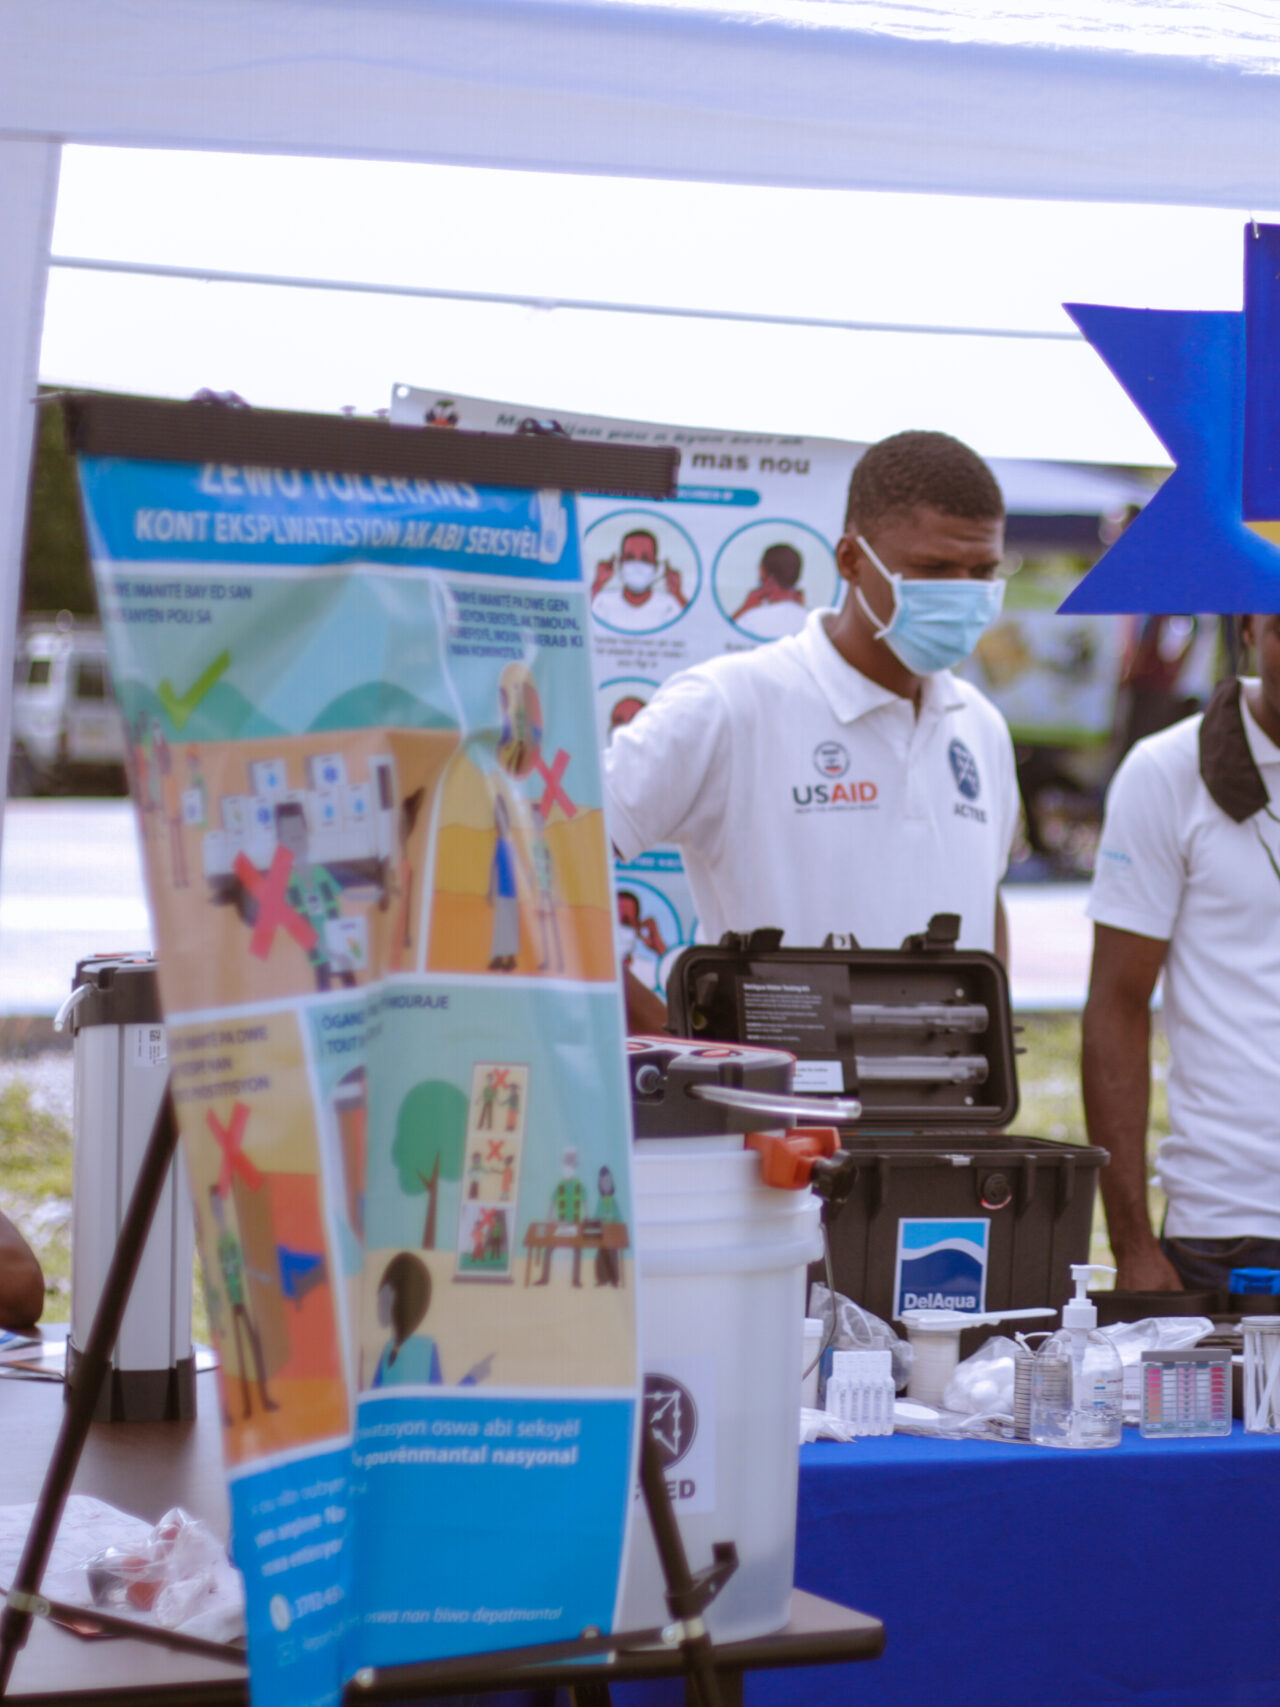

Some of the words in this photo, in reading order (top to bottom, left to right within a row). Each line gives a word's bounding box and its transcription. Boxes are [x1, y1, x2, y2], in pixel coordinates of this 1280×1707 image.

[692, 452, 749, 471] mas
[760, 455, 811, 475] nou
[135, 508, 209, 542] KONT
[792, 781, 879, 806] USAID
[904, 1292, 976, 1310] DelAqua
[431, 1420, 479, 1437] oswa
[483, 1417, 514, 1438] abi
[491, 1445, 579, 1469] nasyonal
